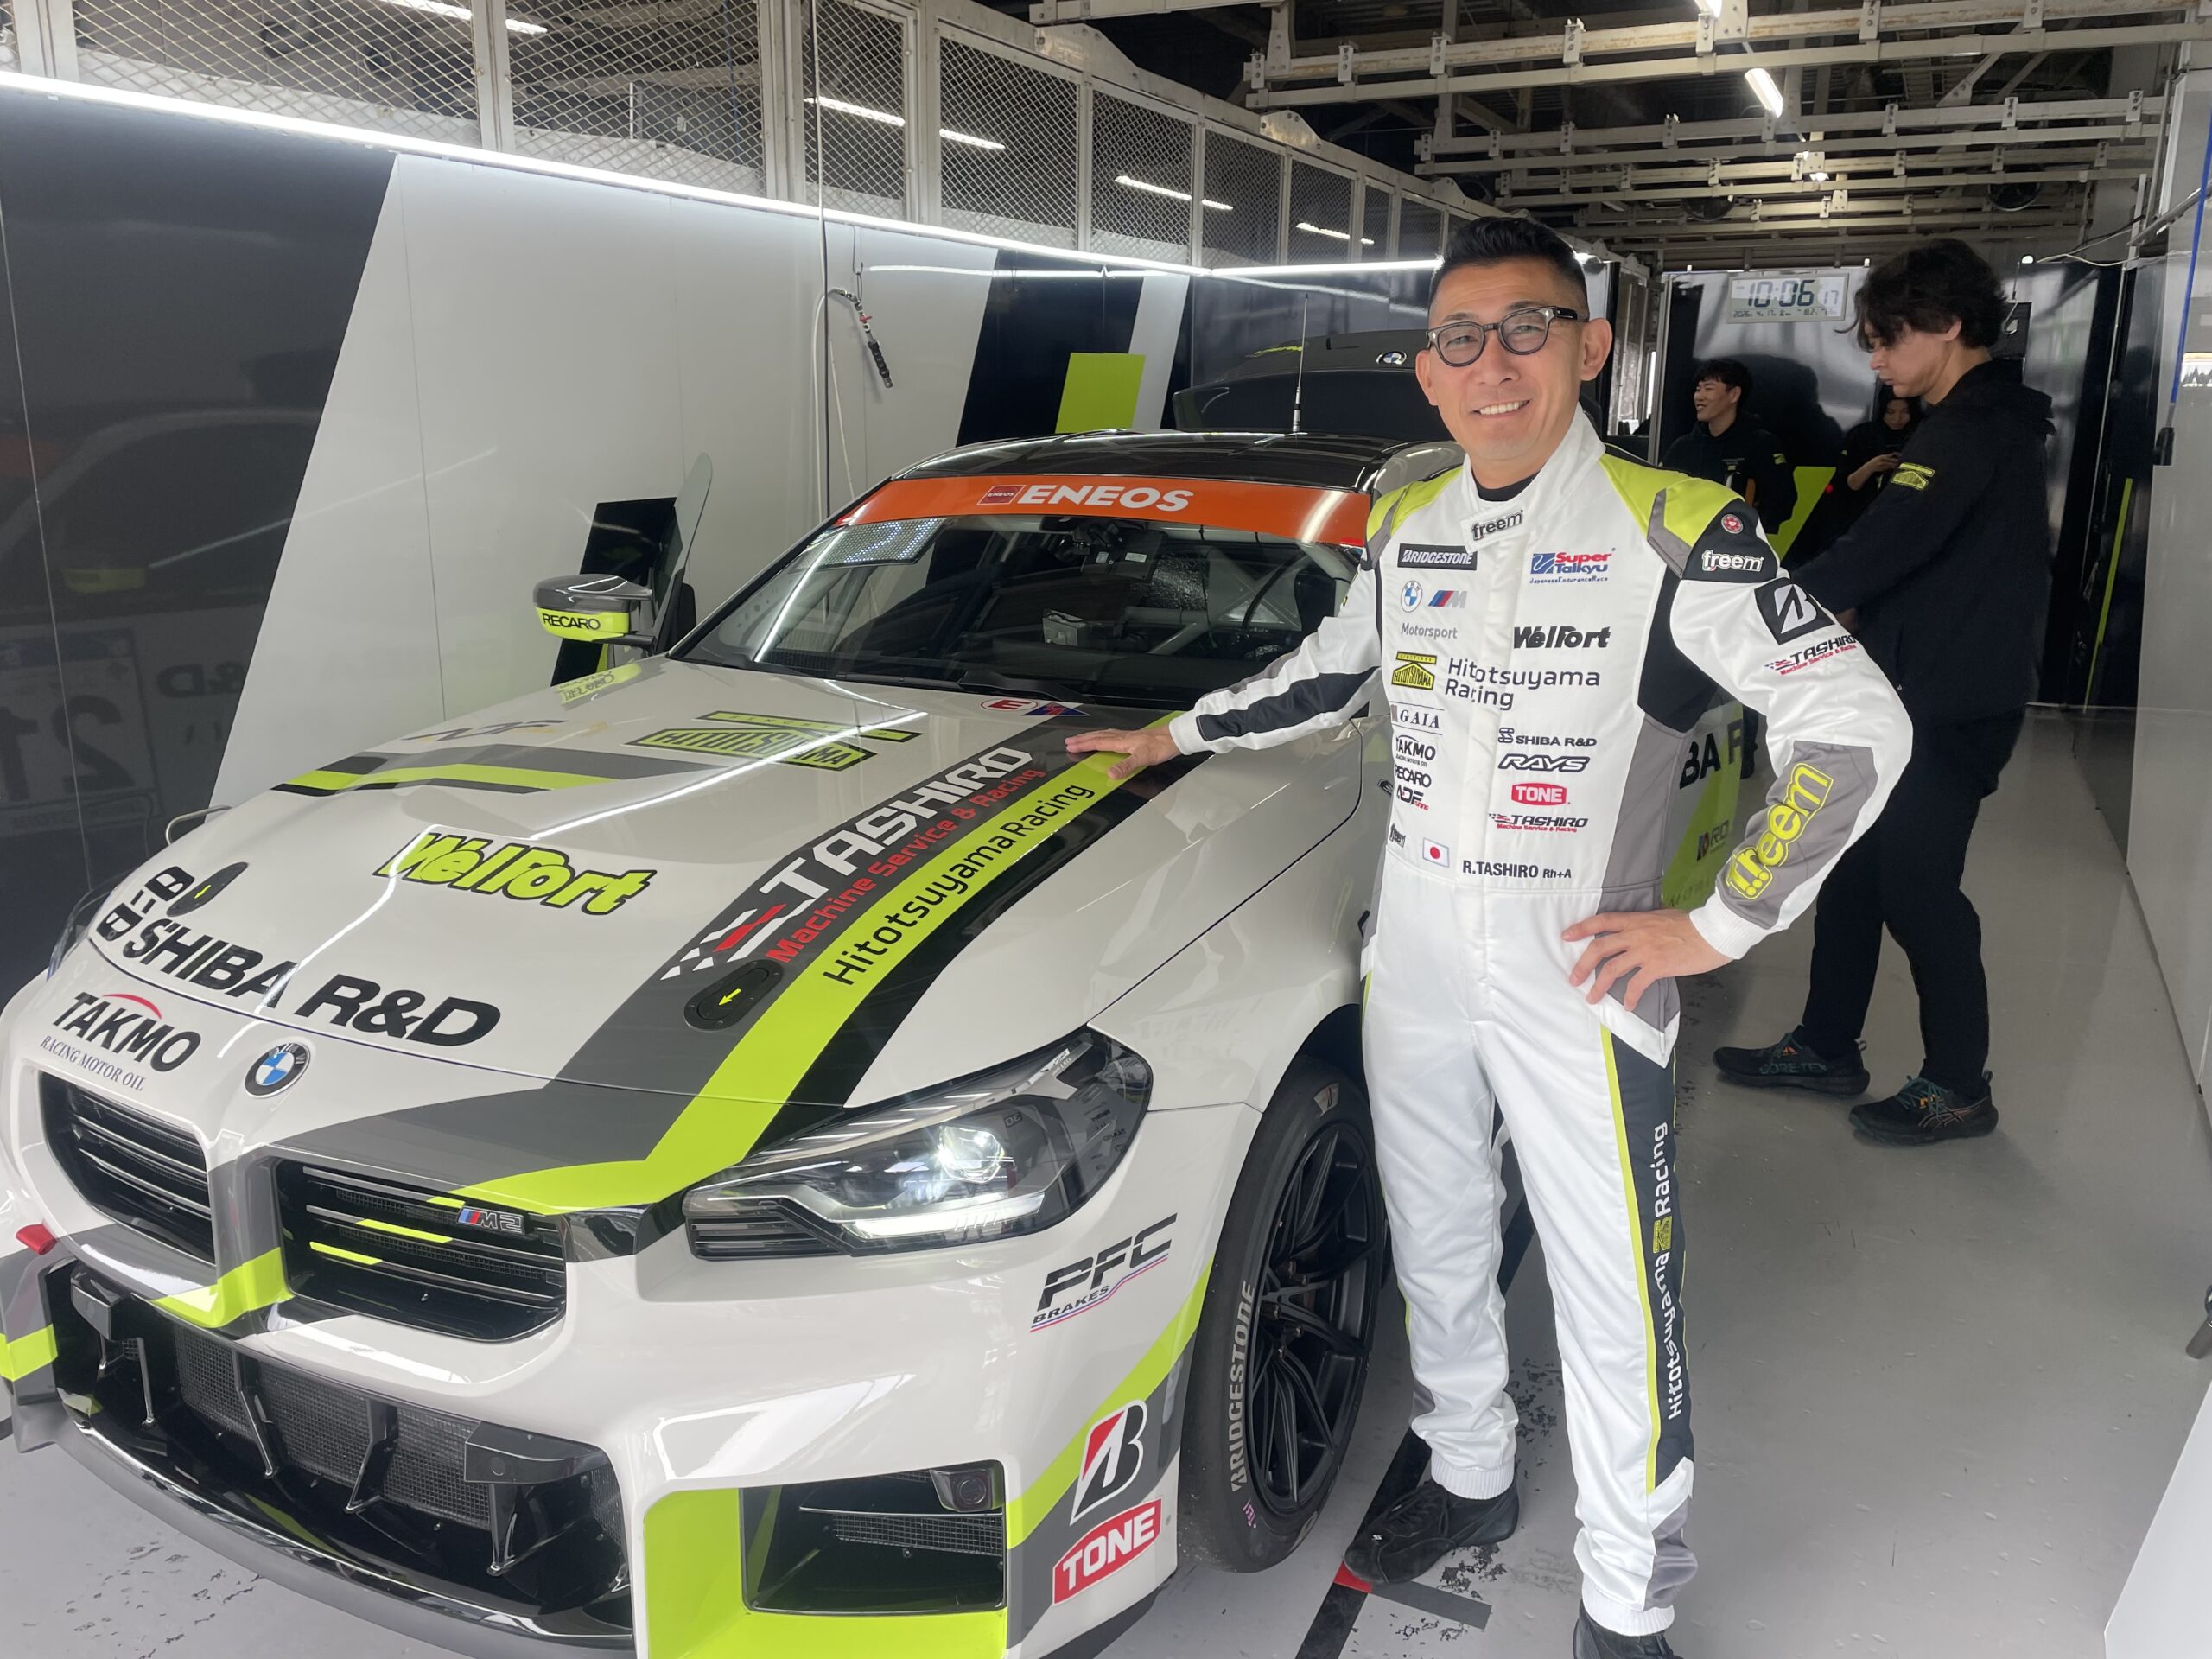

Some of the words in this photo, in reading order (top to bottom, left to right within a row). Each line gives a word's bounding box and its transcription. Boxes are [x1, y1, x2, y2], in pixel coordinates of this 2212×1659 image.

[1747, 279, 1815, 308] 10:06
[1017, 485, 1194, 512] ENEOS
[1471, 510, 1523, 541] freem
[1402, 549, 1473, 565] BRIDGESTONE
[1554, 552, 1612, 563] Super
[1554, 563, 1609, 574] Taikyu
[1702, 550, 1764, 572] freem
[542, 613, 601, 631] RECARO
[1401, 622, 1459, 641] Motorsport
[1448, 658, 1600, 690] Hitotsuyama
[1400, 709, 1440, 729] GAIA
[1516, 735, 1560, 747] SHIBA
[1564, 737, 1598, 747] R&D
[1498, 753, 1591, 772] RAYS
[1515, 785, 1563, 803] TONE
[759, 747, 1033, 900] TASHIRO
[1510, 815, 1589, 828] TASHIRO
[766, 877, 877, 963] Machine
[867, 817, 958, 878] Service
[952, 805, 976, 820] &
[969, 768, 1046, 809] Racing
[1462, 860, 1539, 879] R.TASHIRO
[1542, 868, 1572, 879] Rh+A
[122, 918, 301, 1009] SHIBA
[294, 974, 501, 1046] R&D
[52, 991, 201, 1072] TAKMO
[40, 1035, 79, 1062] RACING
[78, 1052, 123, 1082] MOTOR
[122, 1071, 146, 1091] OIL
[1649, 1122, 1671, 1217] Racing
[1037, 1212, 1178, 1312] PFC
[1033, 1285, 1109, 1324] BRAKES
[1654, 1251, 1684, 1421] Hitotsuyama
[1229, 1280, 1255, 1492] BRIDGESTONE
[1062, 1506, 1155, 1591] TONE
